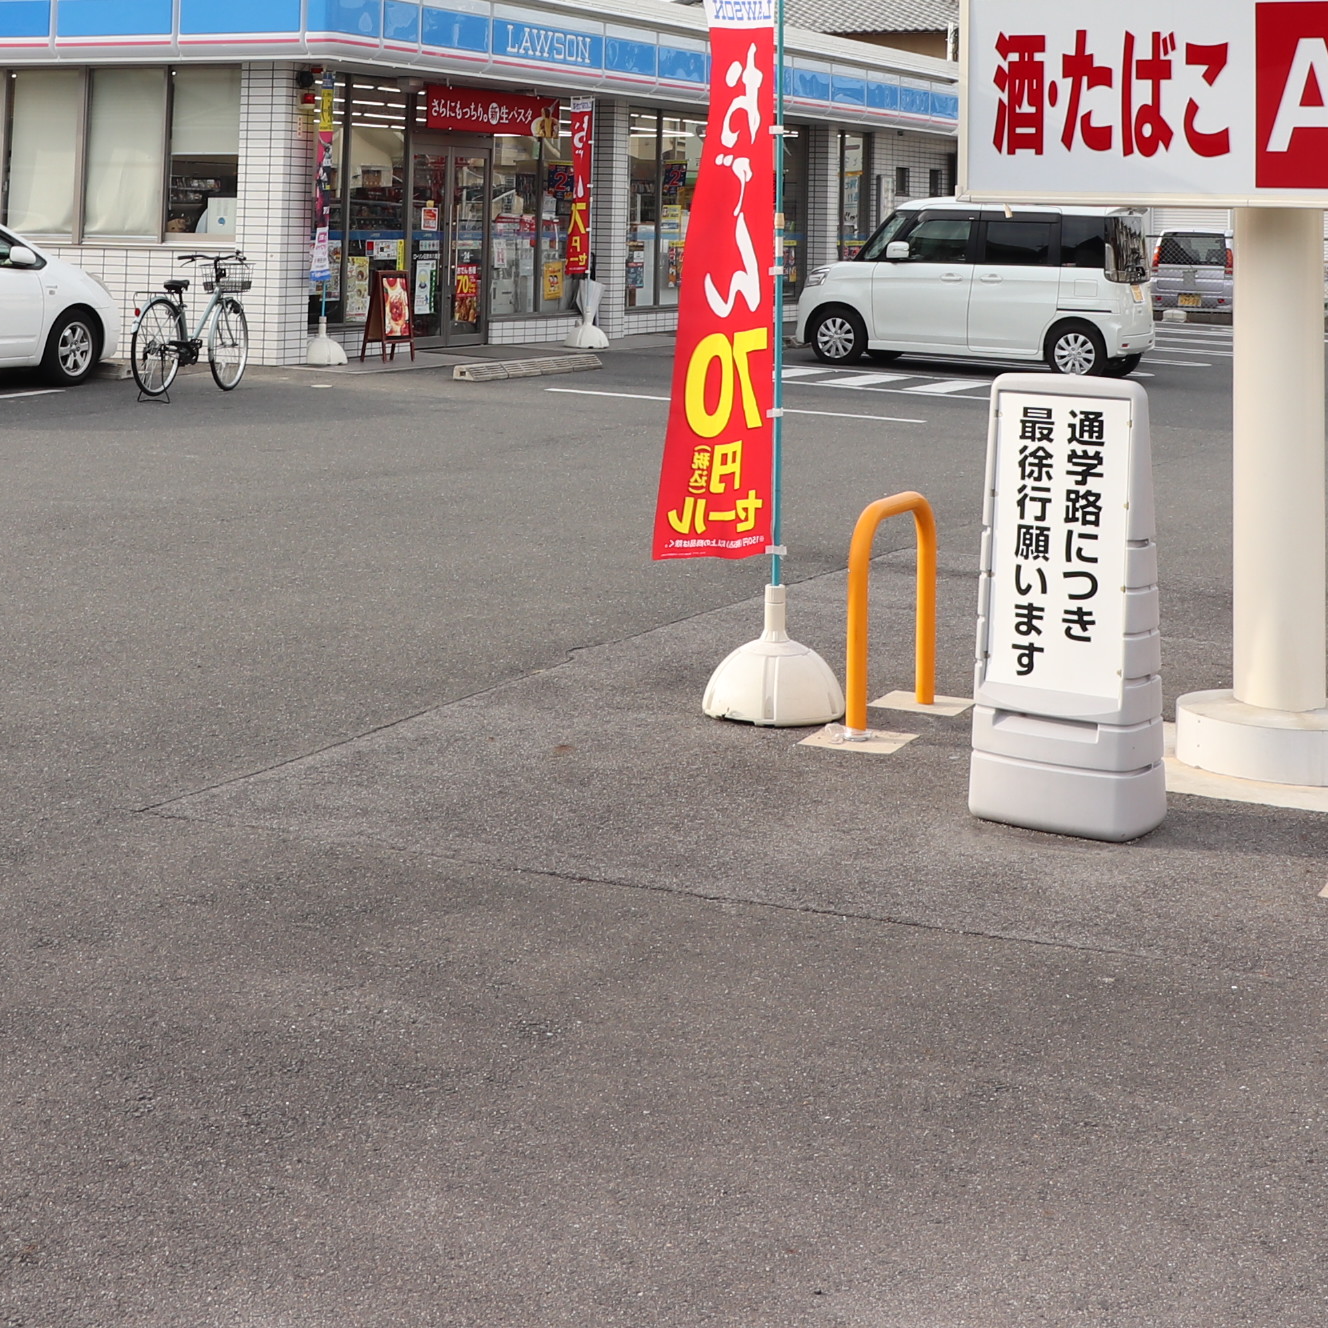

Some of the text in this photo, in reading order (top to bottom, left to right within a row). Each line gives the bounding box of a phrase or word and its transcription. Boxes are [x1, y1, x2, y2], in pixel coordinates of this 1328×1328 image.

[506, 24, 592, 64] LAWSON
[992, 29, 1231, 158] 酒・たばこ
[456, 275, 469, 293] 70
[1011, 407, 1055, 676] 最徐行願います
[1061, 409, 1105, 643] 通学路につき
